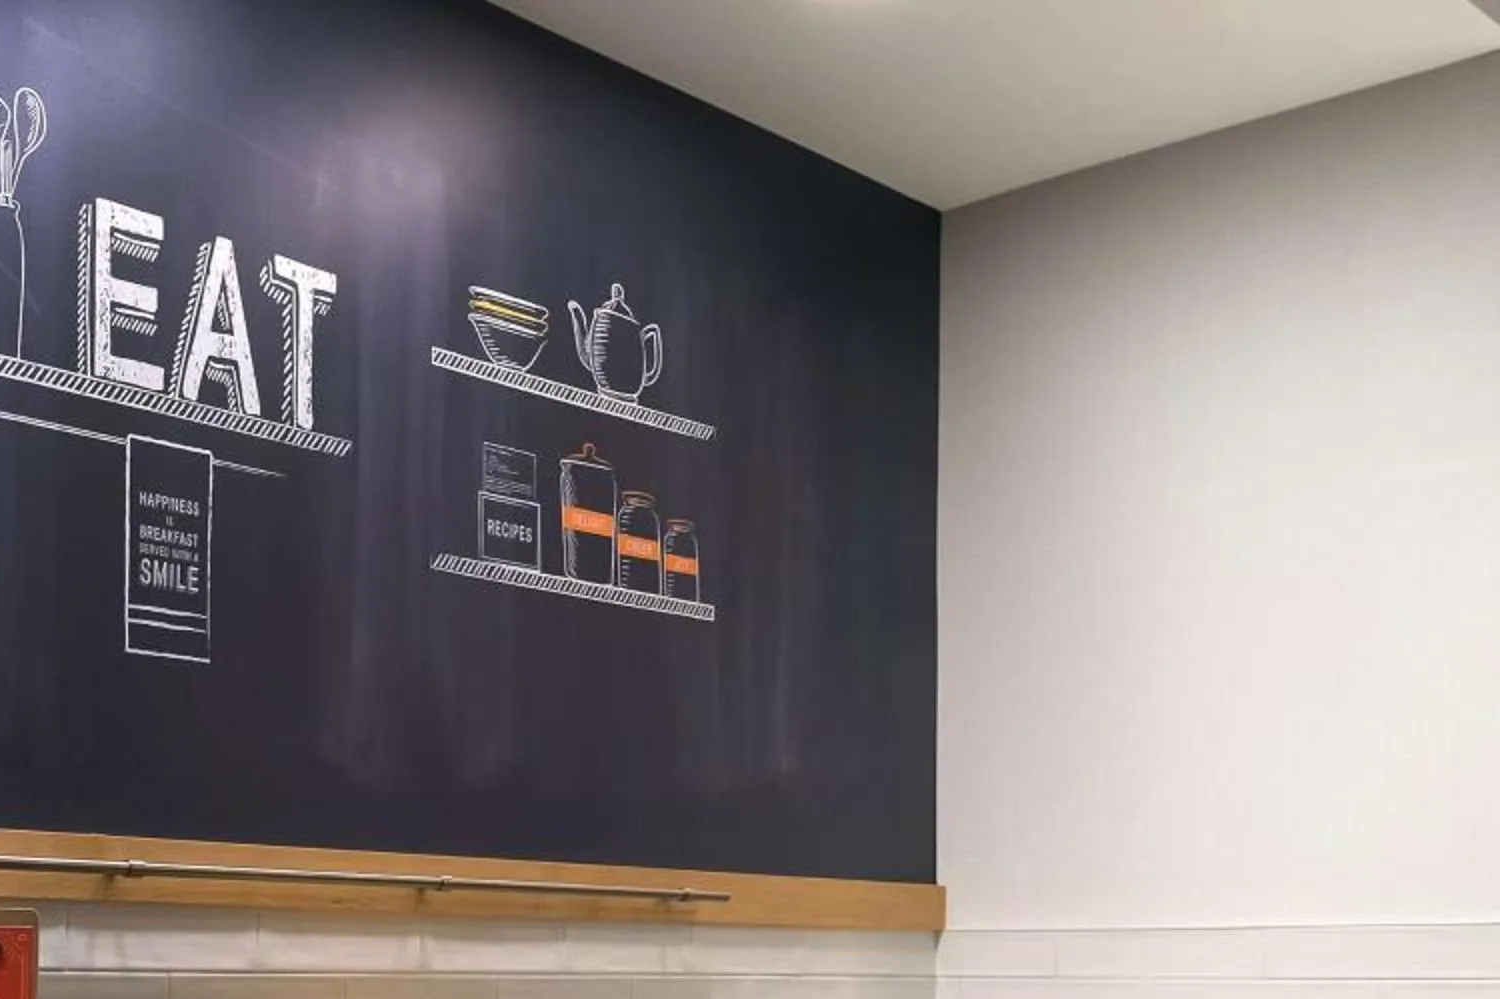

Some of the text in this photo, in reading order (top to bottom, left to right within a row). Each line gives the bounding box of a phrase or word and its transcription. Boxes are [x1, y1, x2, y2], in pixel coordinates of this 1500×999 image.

[78, 197, 338, 430] EAT
[138, 491, 201, 517] HAPPINESS
[138, 524, 199, 549] BREAKFAST
[486, 518, 534, 544] RECIPES
[139, 557, 200, 594] SMILE
